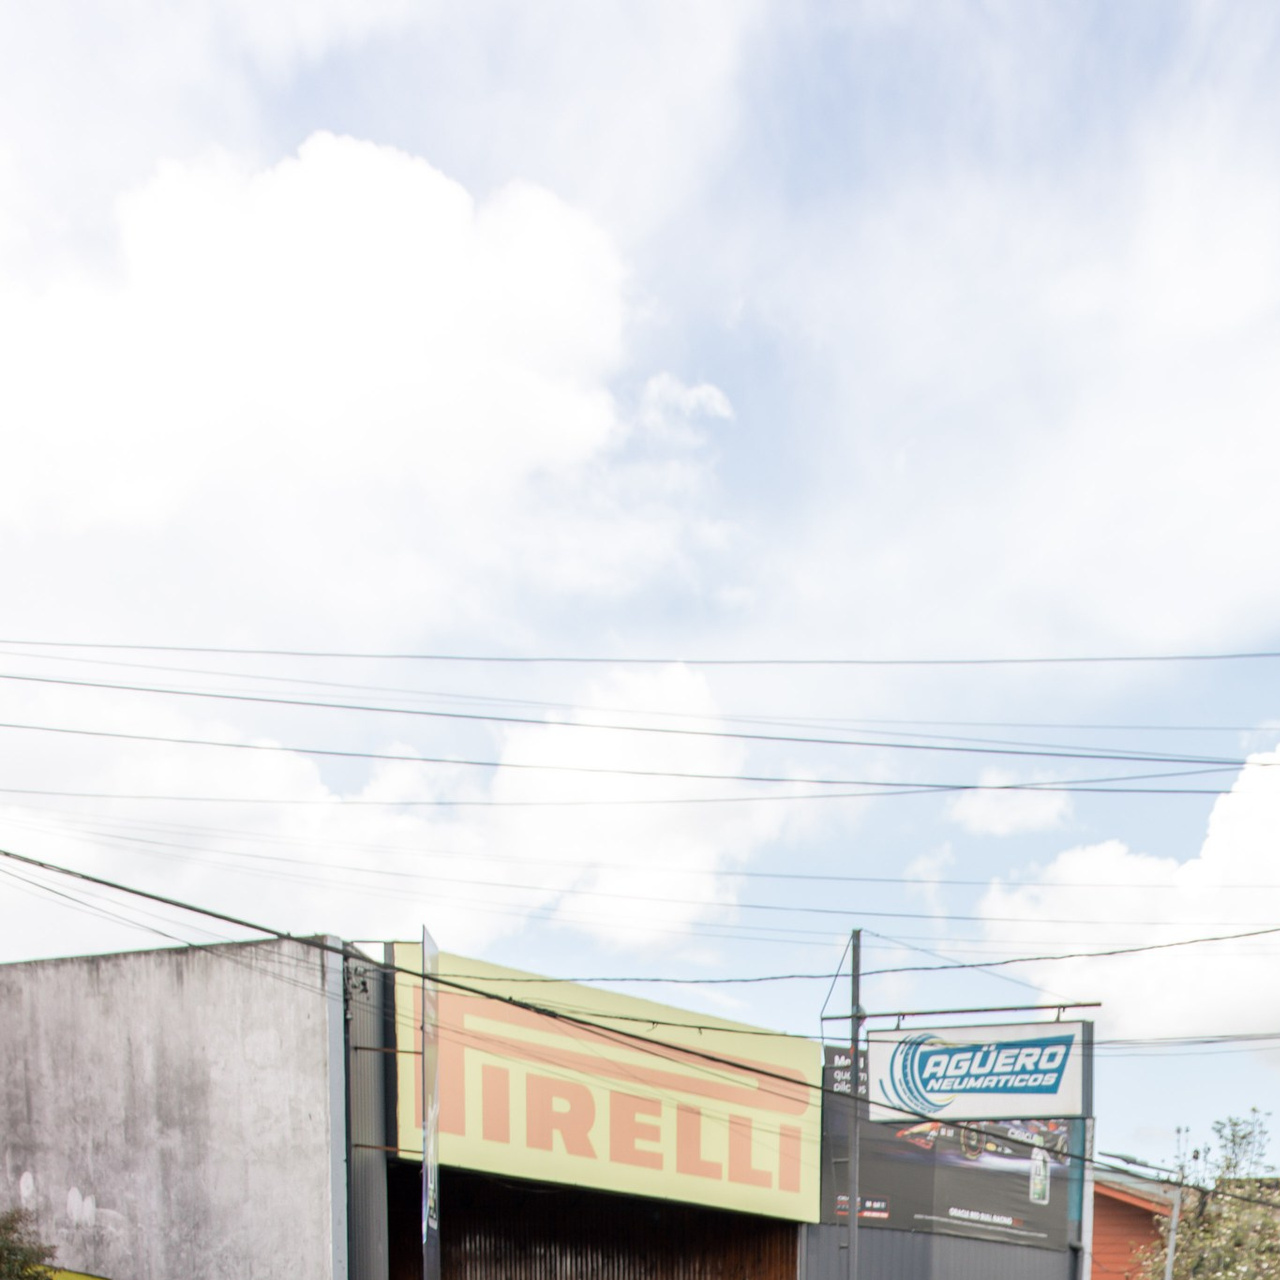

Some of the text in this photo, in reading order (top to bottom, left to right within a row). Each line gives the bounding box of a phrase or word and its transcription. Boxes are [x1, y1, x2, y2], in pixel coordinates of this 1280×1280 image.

[922, 1044, 1068, 1080] AGÜERO
[413, 984, 811, 1194] PIRELLI
[926, 1073, 1059, 1092] NEUMATICOS
